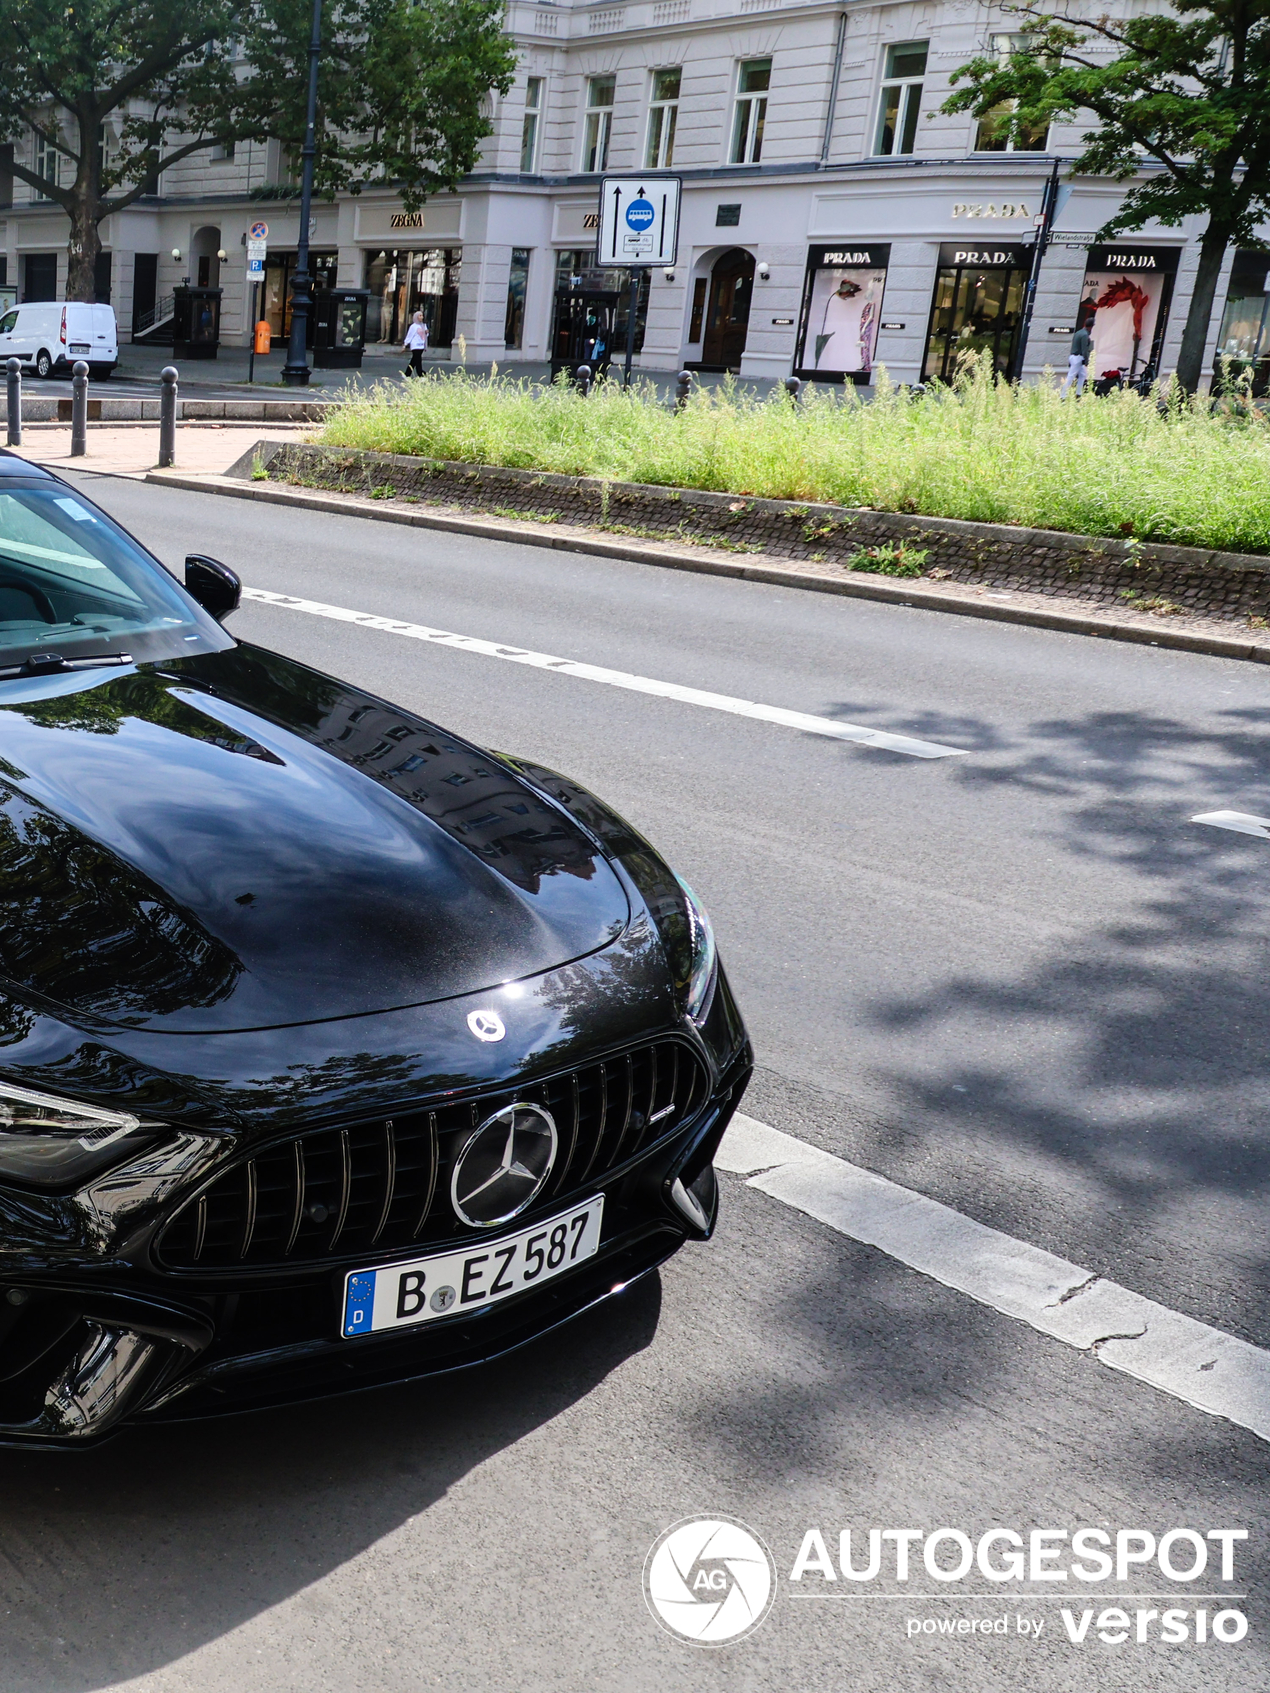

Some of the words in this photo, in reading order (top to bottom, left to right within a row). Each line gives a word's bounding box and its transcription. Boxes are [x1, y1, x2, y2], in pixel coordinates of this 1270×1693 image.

[952, 203, 1030, 219] PRADA
[390, 213, 424, 227] ZEGNA
[1054, 234, 1093, 242] Wielandstraße
[823, 252, 871, 264] PRADA
[954, 251, 1016, 264] PRADA
[1106, 254, 1157, 268] PRADA
[396, 1270, 426, 1319] B
[459, 1244, 518, 1304] EZ
[523, 1211, 590, 1281] 587
[353, 1309, 364, 1324] D
